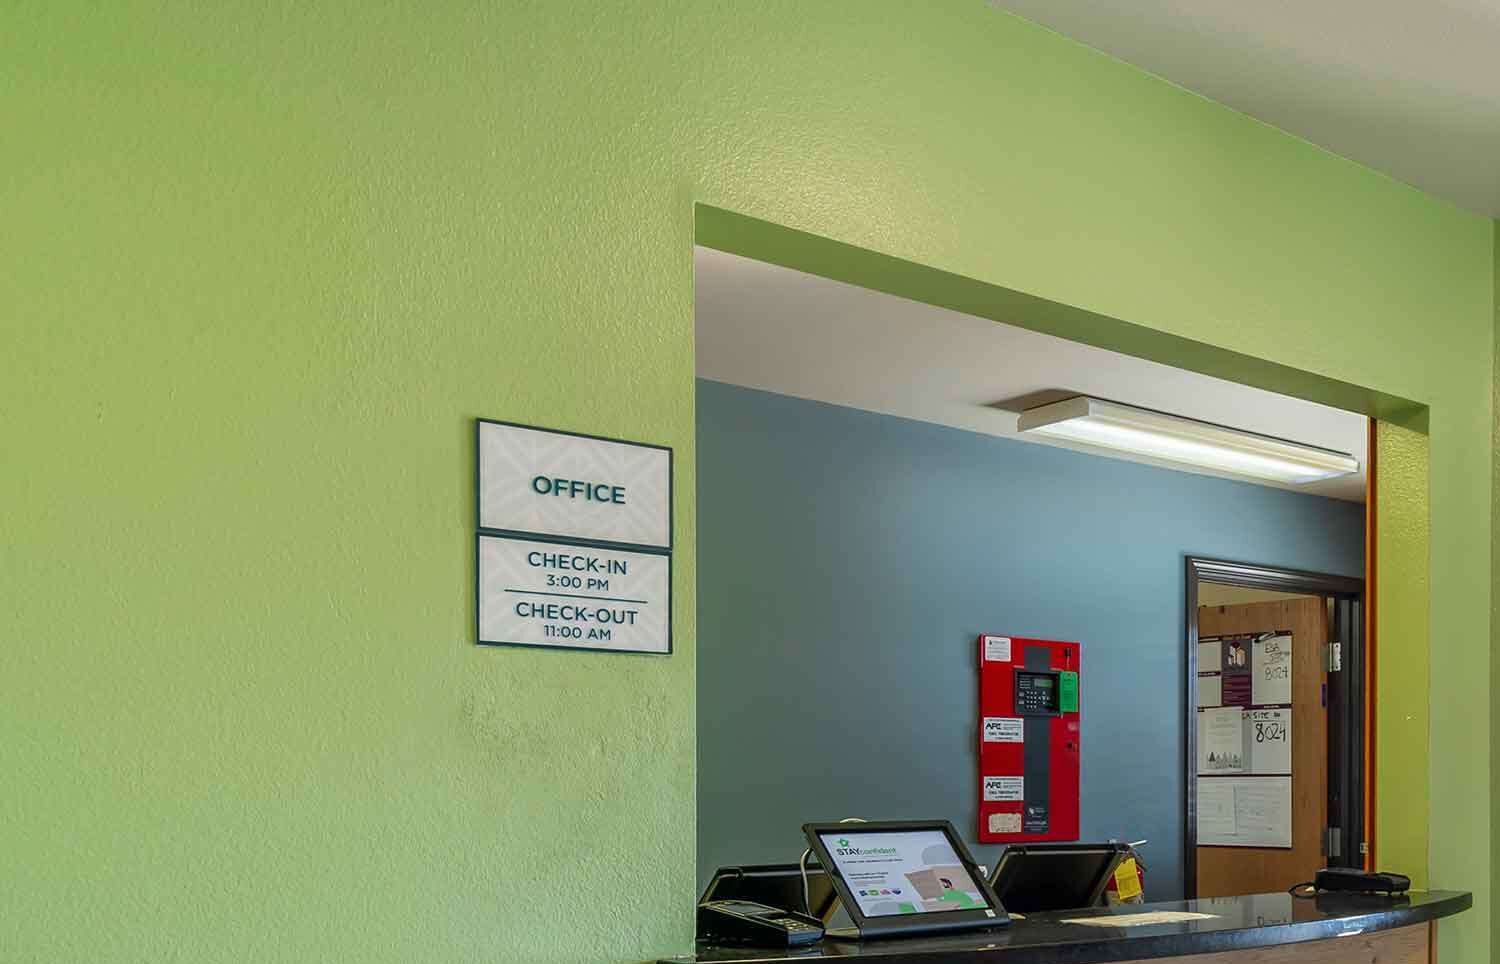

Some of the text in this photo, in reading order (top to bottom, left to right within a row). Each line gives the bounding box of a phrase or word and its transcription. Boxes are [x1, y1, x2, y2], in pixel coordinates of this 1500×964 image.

[532, 475, 626, 504] OFFICE
[528, 552, 627, 575] CHECK-IN
[546, 574, 609, 591] 3:00 PM
[516, 602, 638, 625] CHECK-OUT
[544, 625, 611, 640] 11:00 AM
[1255, 722, 1286, 743] 8024
